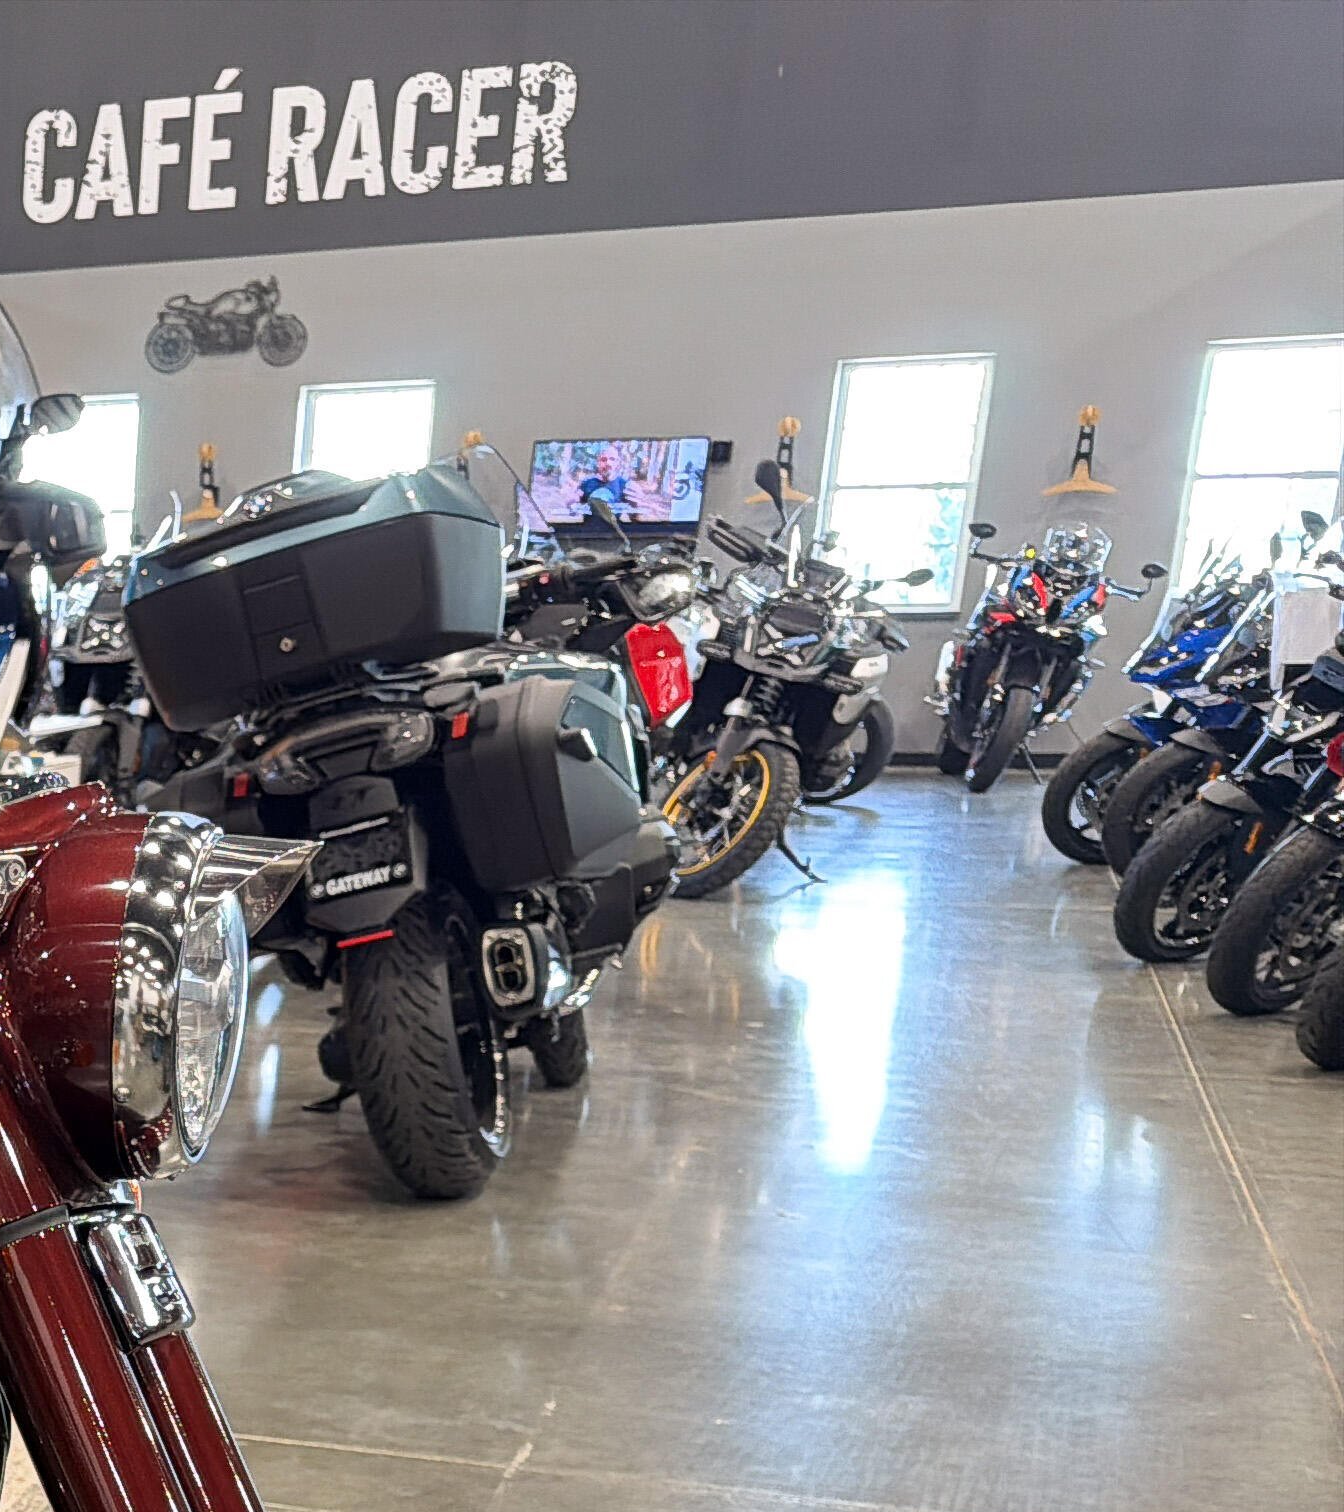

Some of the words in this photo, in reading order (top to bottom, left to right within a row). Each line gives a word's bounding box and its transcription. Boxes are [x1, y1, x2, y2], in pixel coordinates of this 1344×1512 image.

[23, 67, 244, 224] CAFÉ
[264, 61, 578, 206] RACER
[325, 865, 392, 896] GATEWAY
